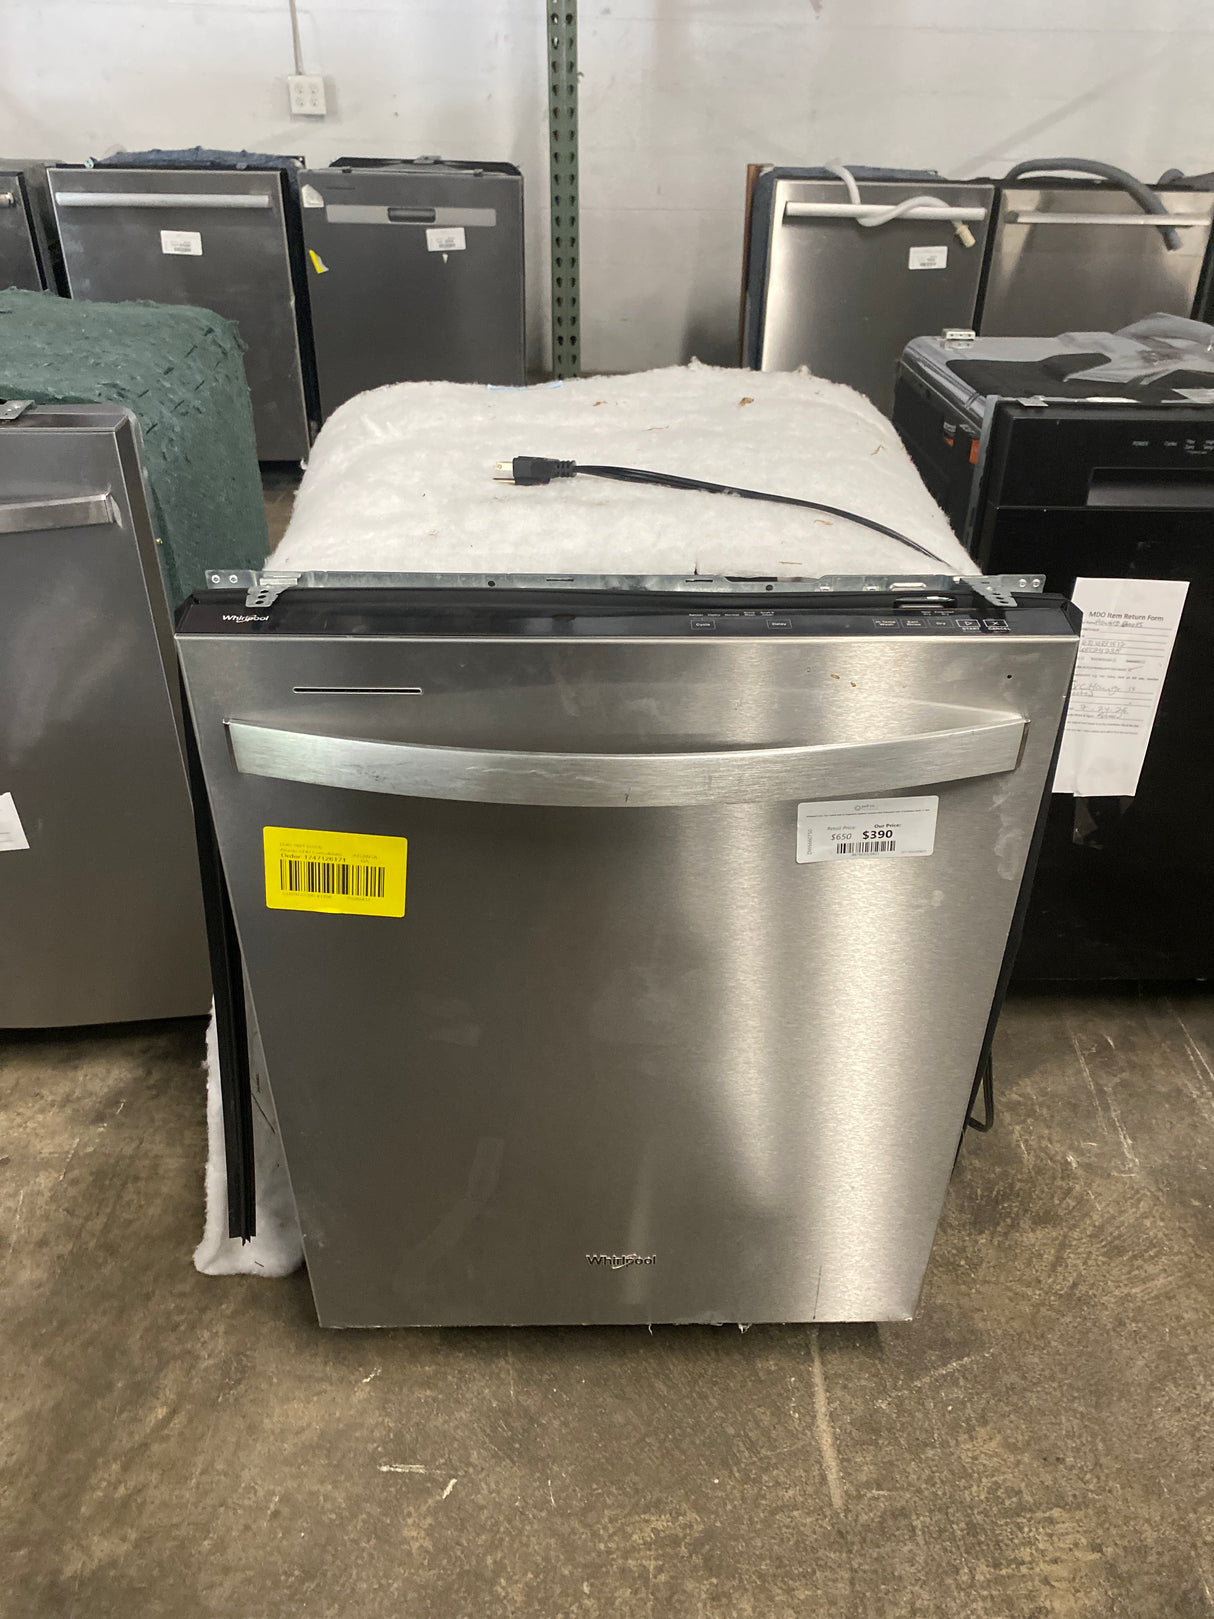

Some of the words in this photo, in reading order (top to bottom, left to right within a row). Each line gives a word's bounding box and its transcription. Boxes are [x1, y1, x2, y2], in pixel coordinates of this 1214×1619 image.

[222, 614, 270, 623] Whirlpool
[1123, 613, 1147, 621] Return
[1147, 614, 1165, 622] Form
[831, 832, 852, 841] $650
[862, 829, 893, 840] $390
[586, 1253, 657, 1269] Whirlpool
